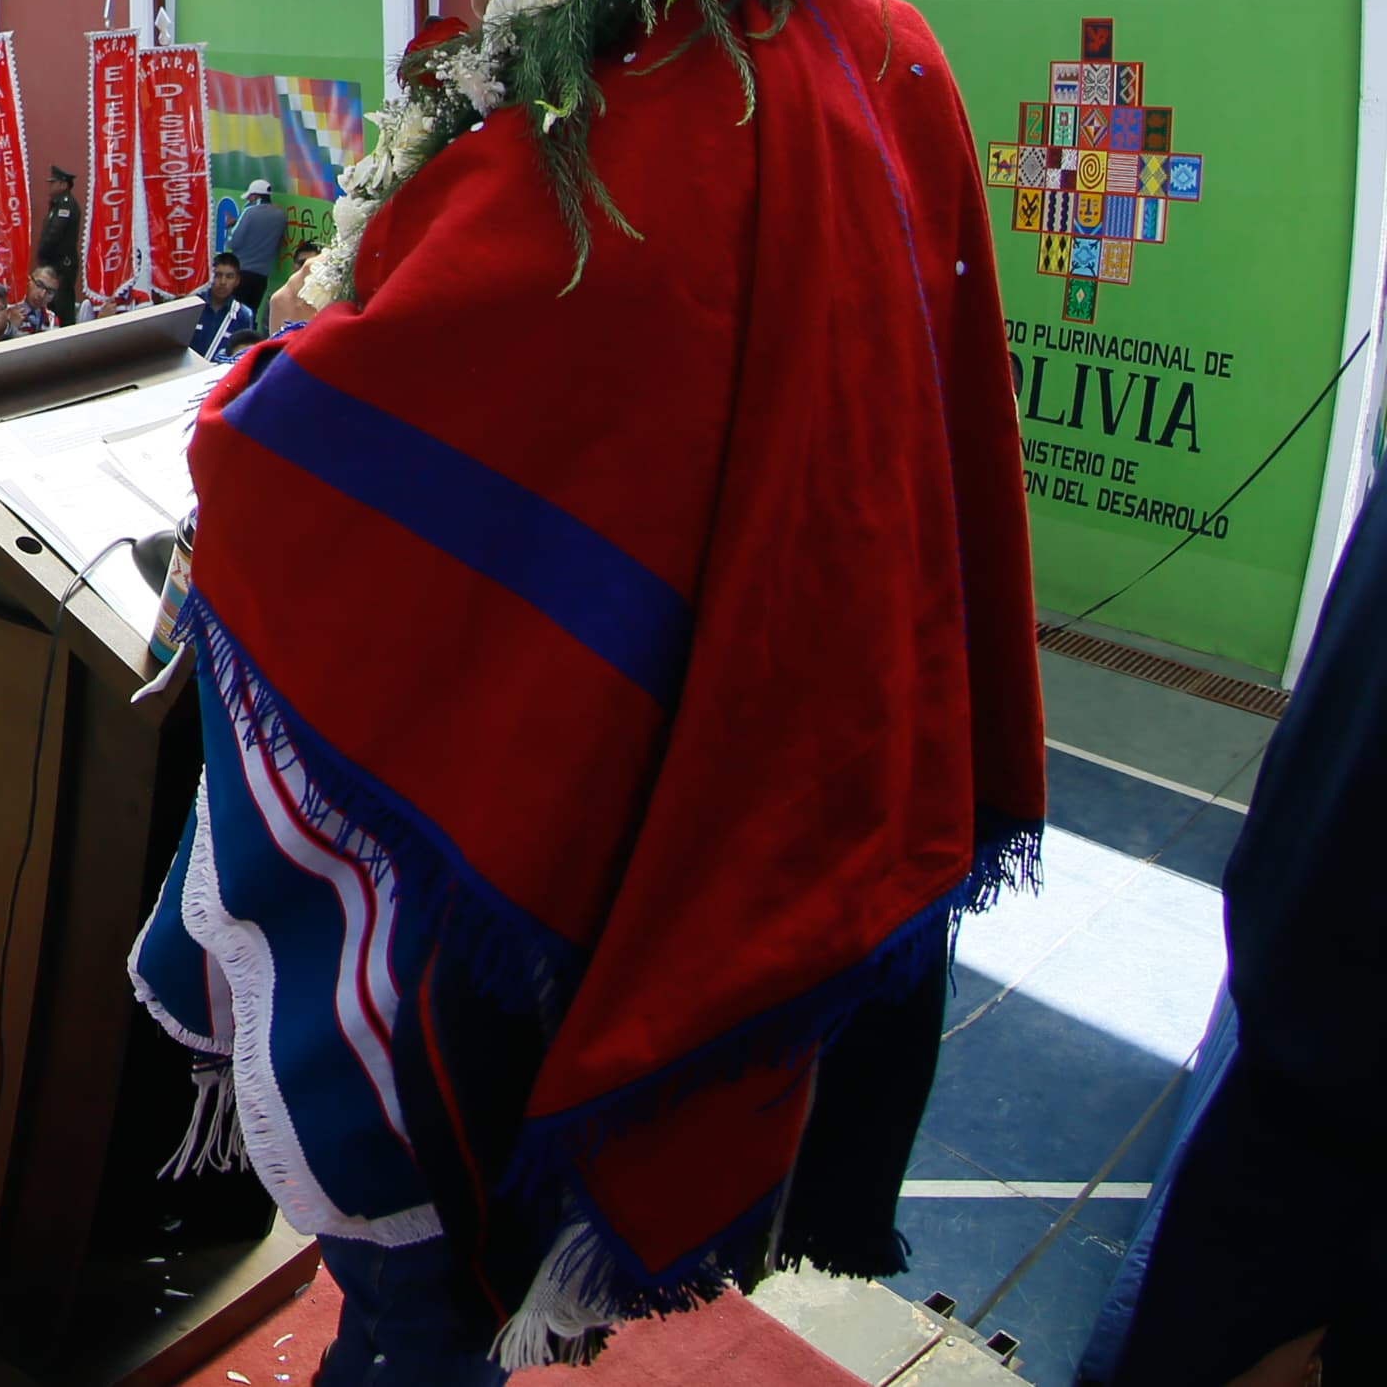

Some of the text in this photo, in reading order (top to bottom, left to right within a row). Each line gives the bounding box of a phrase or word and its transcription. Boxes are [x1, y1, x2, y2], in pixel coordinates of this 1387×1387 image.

[102, 66, 126, 272] ELECTRICIDAD
[1033, 324, 1196, 373] PLURINACIONAL
[1204, 351, 1234, 379] DE
[1020, 437, 1139, 485] NISTERIO DE
[1052, 477, 1089, 507] DEL
[1096, 488, 1229, 539] DESARROLLO
